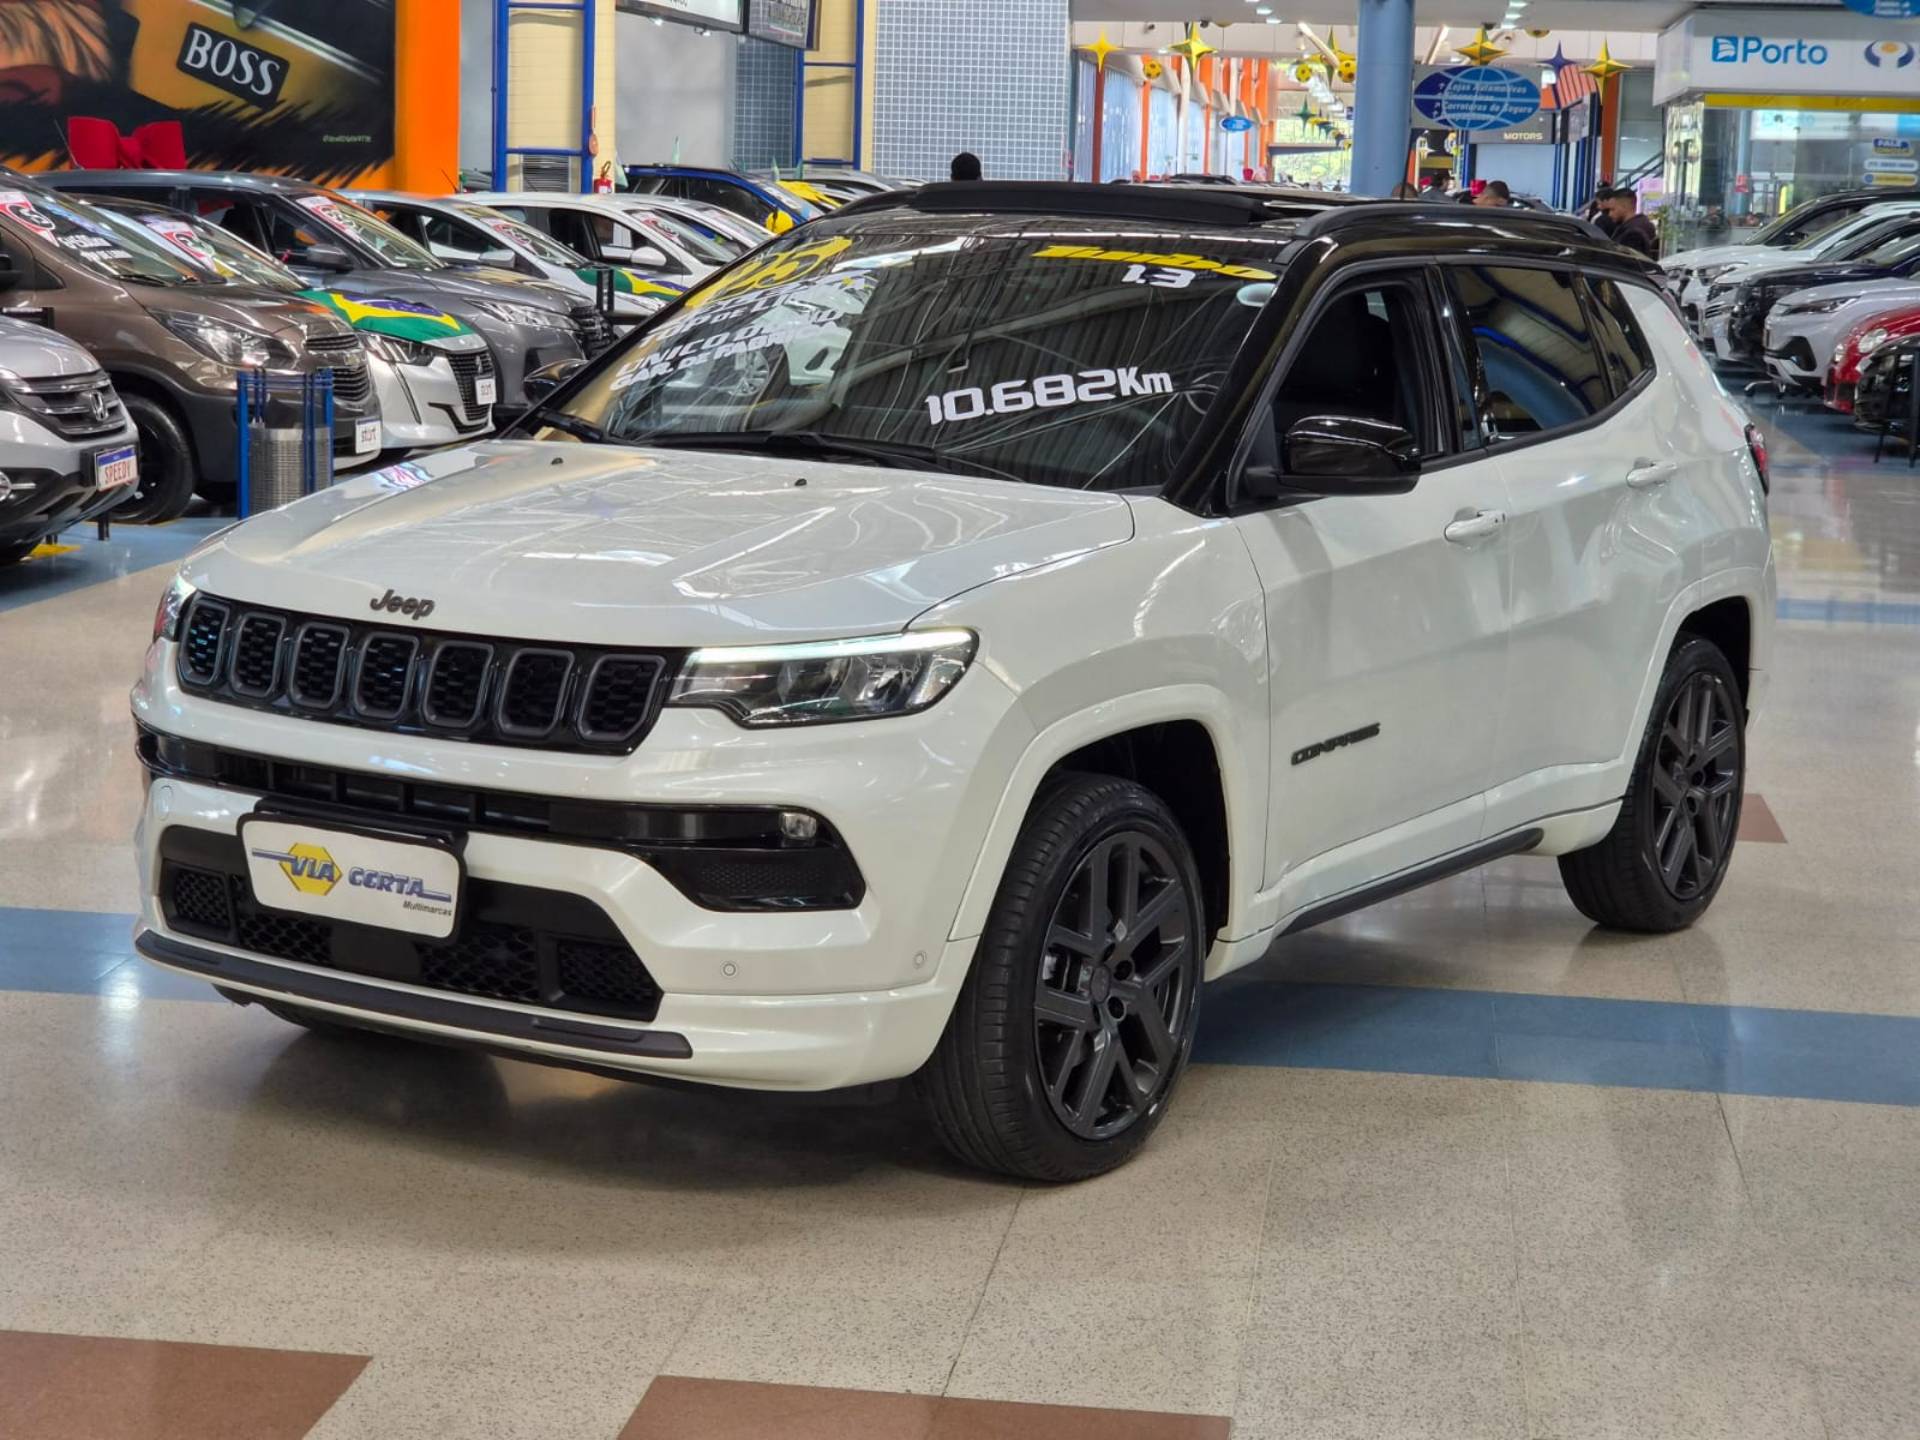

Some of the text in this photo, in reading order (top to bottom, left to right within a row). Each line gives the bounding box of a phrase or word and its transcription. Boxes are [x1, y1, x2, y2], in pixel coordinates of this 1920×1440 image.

[184, 28, 280, 96] BOSS
[1741, 36, 1828, 65] Porto
[1503, 131, 1543, 141] MOTORS
[1121, 263, 1197, 289] 1.3
[369, 588, 435, 621] Jeep
[287, 855, 337, 882] VIA
[402, 900, 453, 917] Multimarcas
